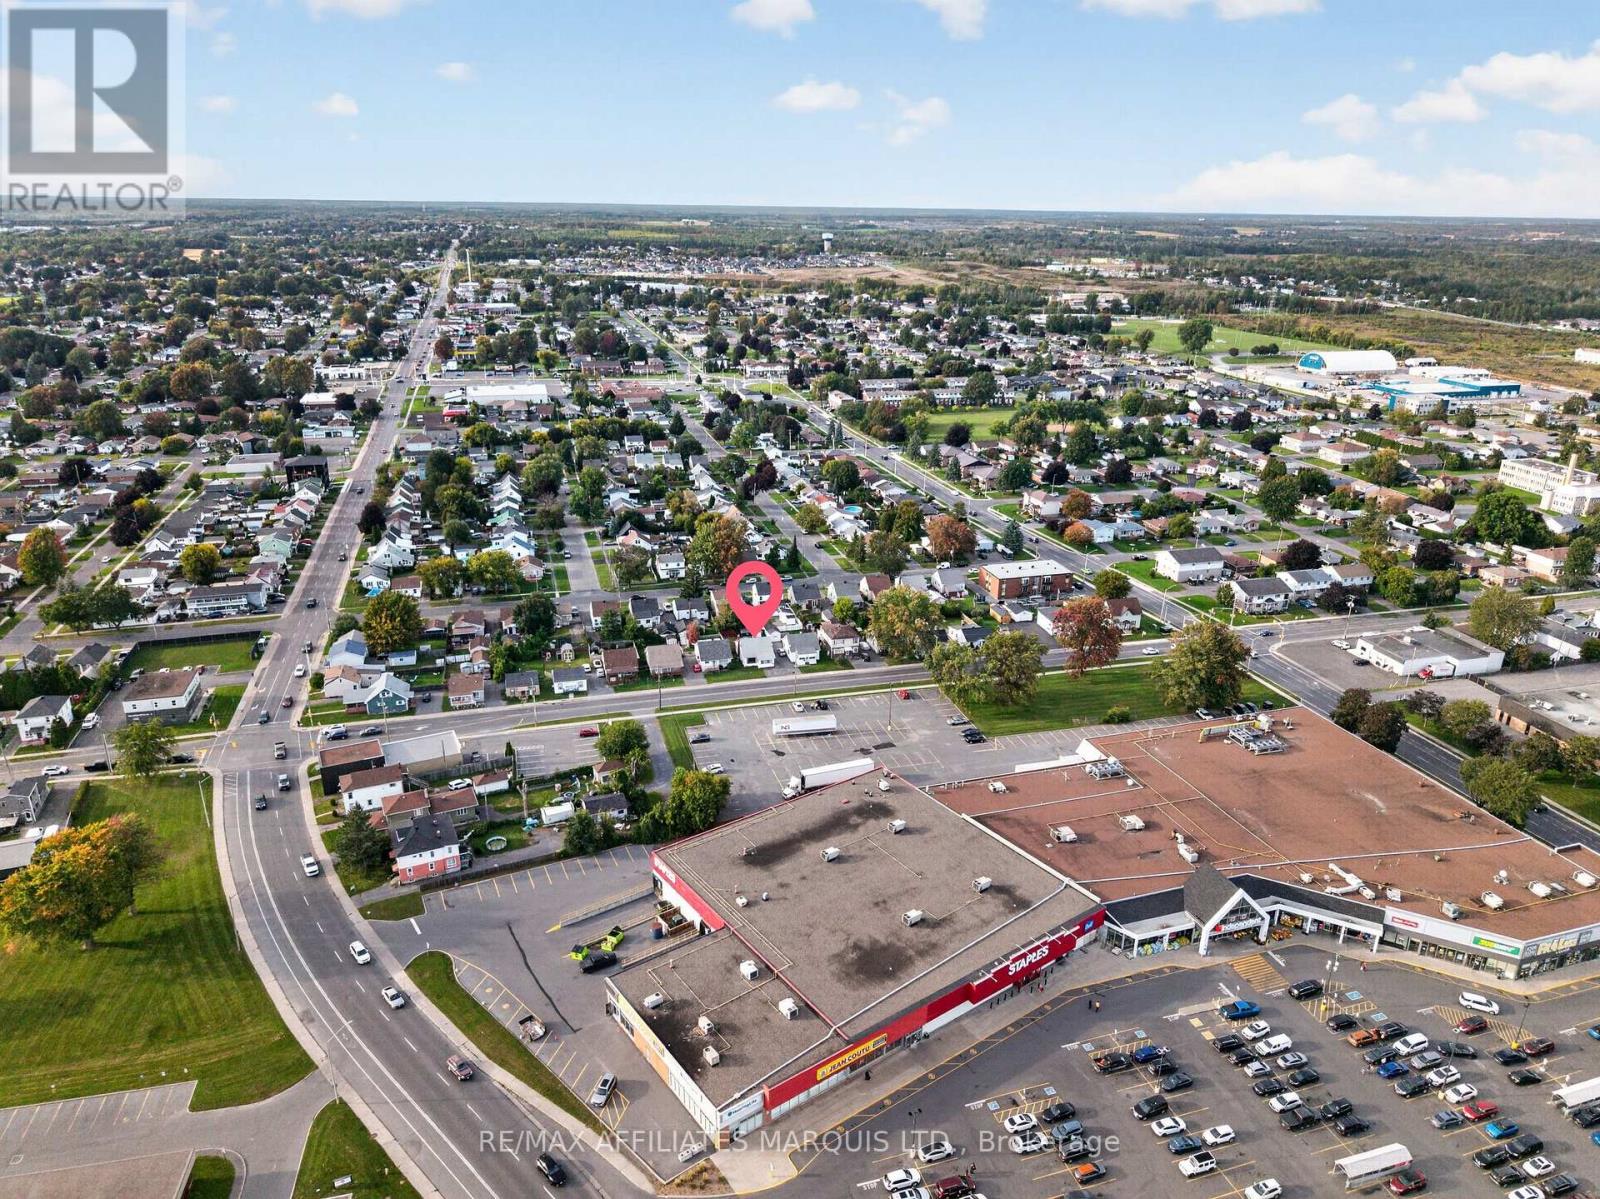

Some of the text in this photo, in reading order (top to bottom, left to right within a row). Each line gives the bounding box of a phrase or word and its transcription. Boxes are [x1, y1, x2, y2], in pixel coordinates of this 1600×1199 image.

[1008, 945, 1049, 975] STAPLES
[829, 1046, 870, 1072] JEAN COUTU
[970, 1103, 984, 1111] STOP
[862, 1182, 878, 1191] STOP
